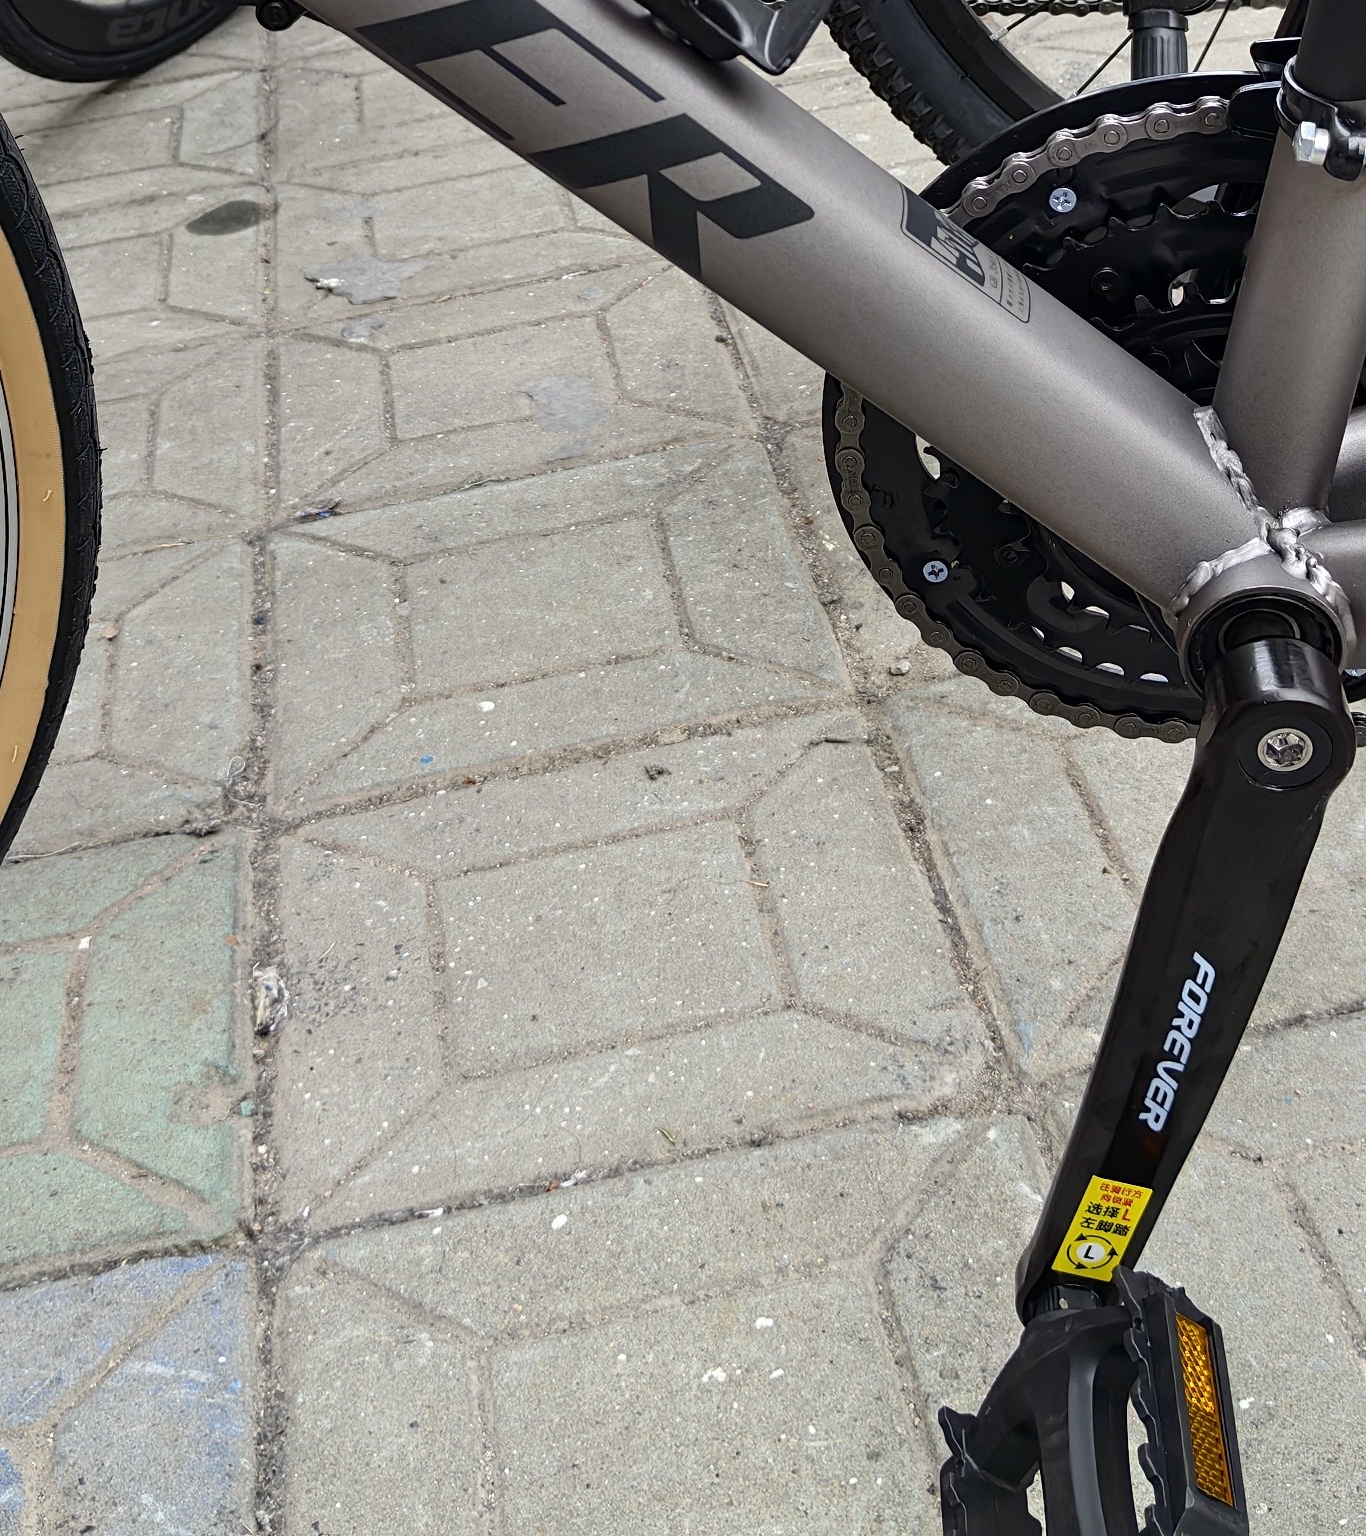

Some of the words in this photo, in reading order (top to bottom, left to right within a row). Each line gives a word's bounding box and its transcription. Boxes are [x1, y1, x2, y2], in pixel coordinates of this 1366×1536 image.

[1138, 950, 1217, 1133] FOREVER
[1079, 1216, 1132, 1237] 左脚踏
[1083, 1245, 1095, 1260] L
